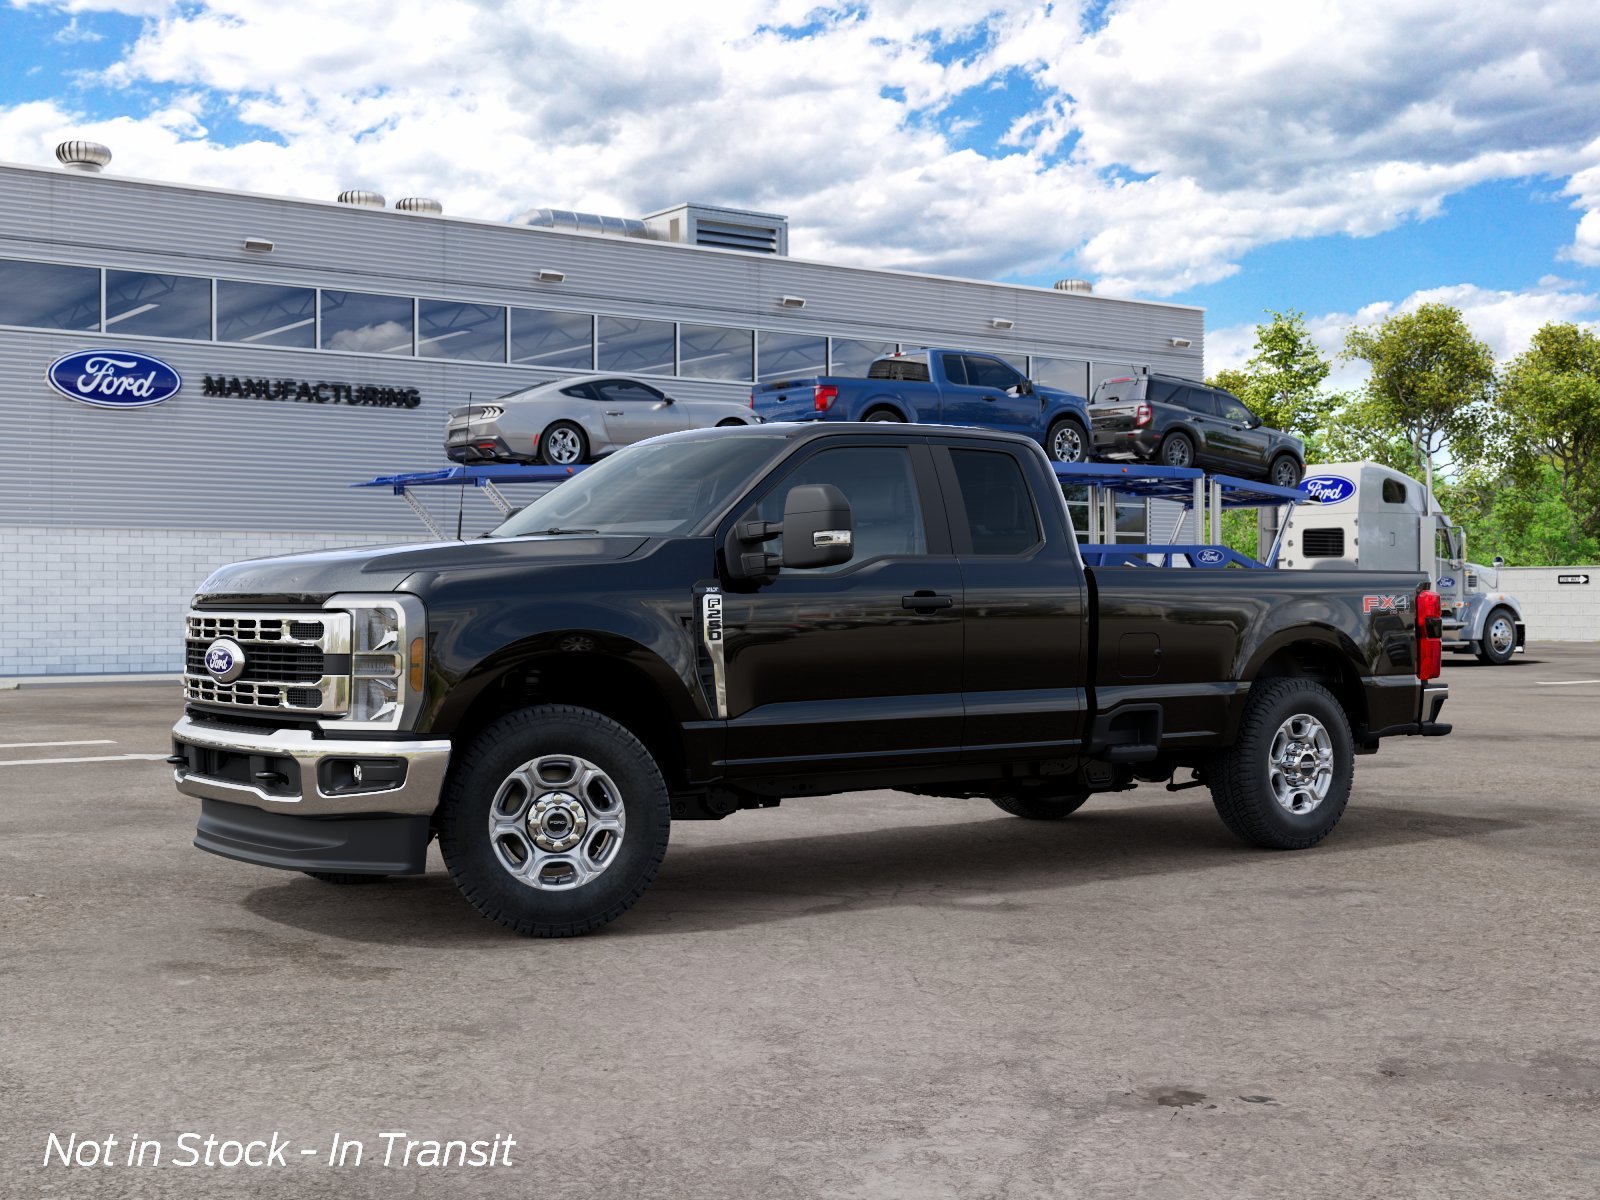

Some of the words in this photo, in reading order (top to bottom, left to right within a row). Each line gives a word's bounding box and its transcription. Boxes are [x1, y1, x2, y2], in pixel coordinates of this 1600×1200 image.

[77, 356, 156, 398] Ford
[203, 374, 421, 409] MANUFACTURING
[1306, 480, 1343, 500] Ford
[1363, 594, 1410, 615] FX4
[707, 598, 722, 641] F250
[210, 650, 229, 670] Ford
